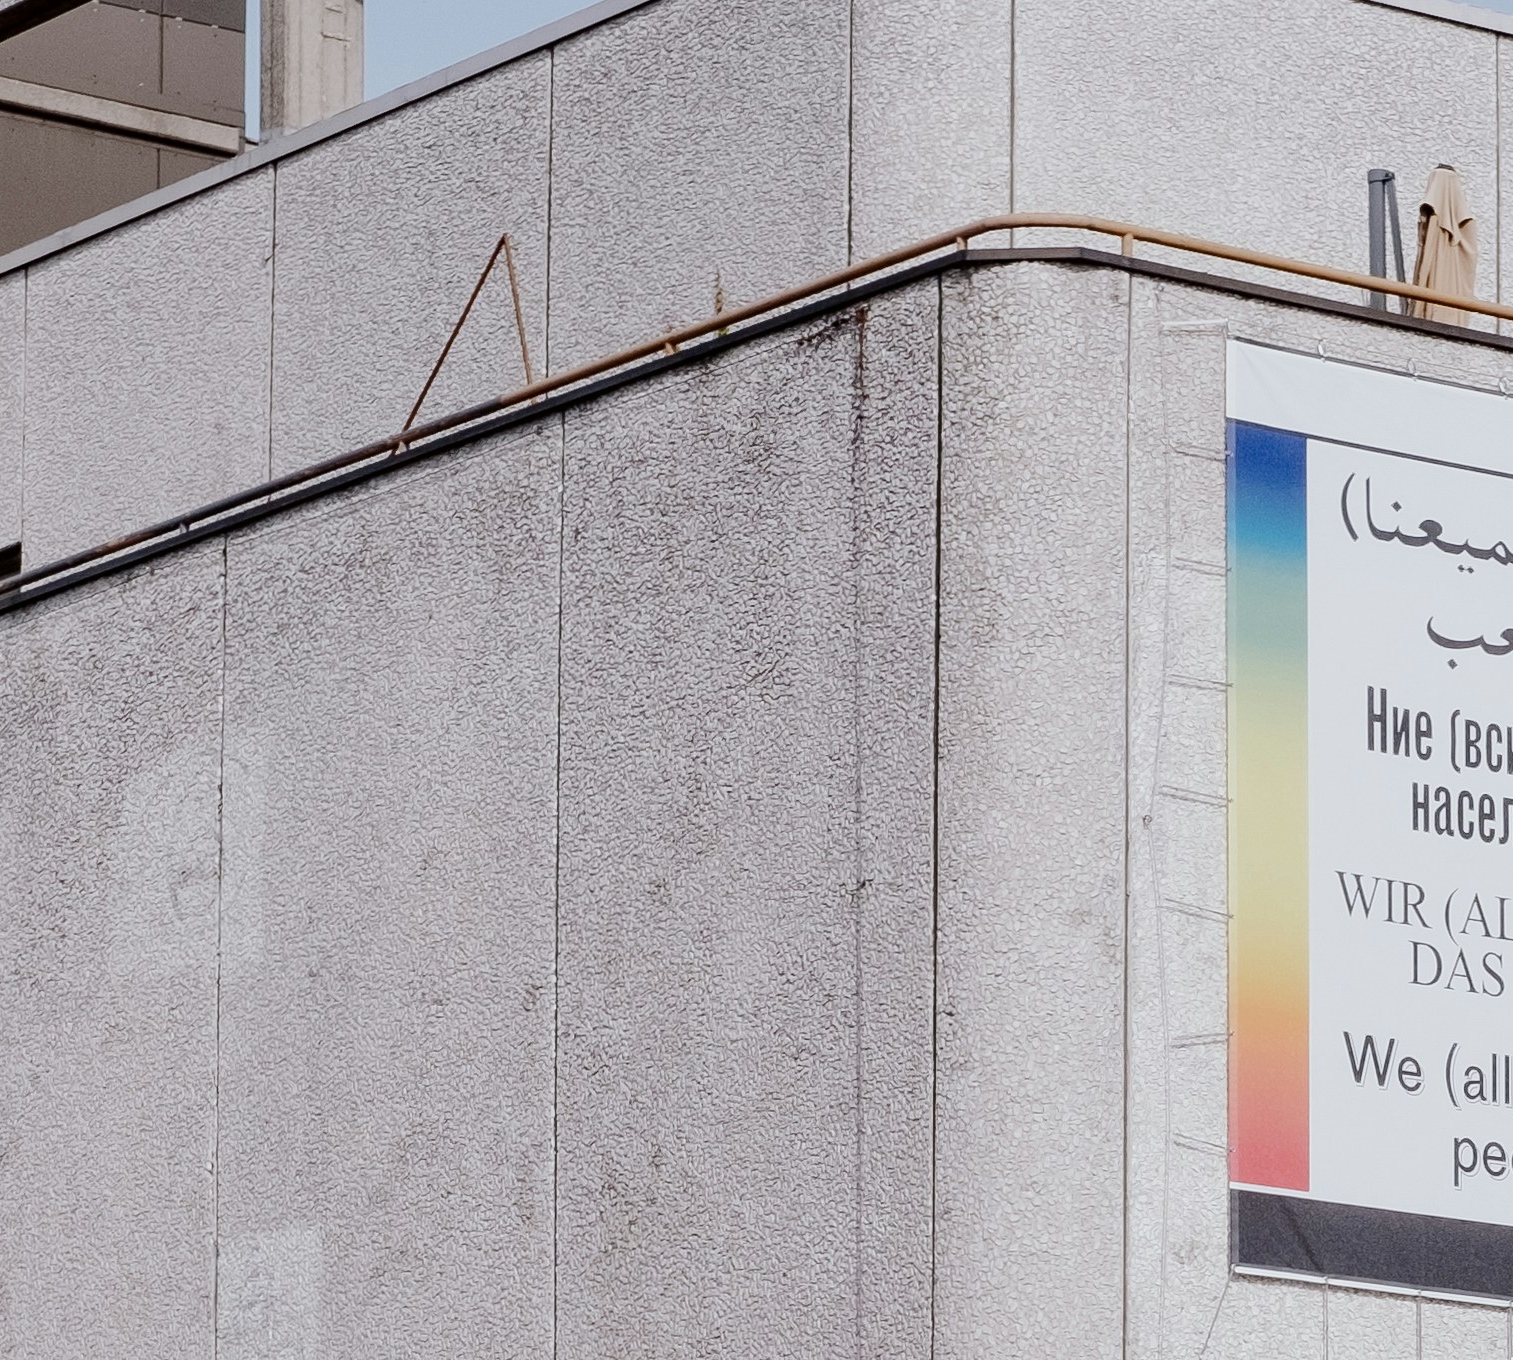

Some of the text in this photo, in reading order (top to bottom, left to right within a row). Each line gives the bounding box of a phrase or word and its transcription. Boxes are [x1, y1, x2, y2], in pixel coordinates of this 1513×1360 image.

[1367, 686, 1433, 760] Ние
[1335, 870, 1433, 929] WIR
[1408, 939, 1505, 998] DAS
[1343, 1030, 1424, 1095] We
